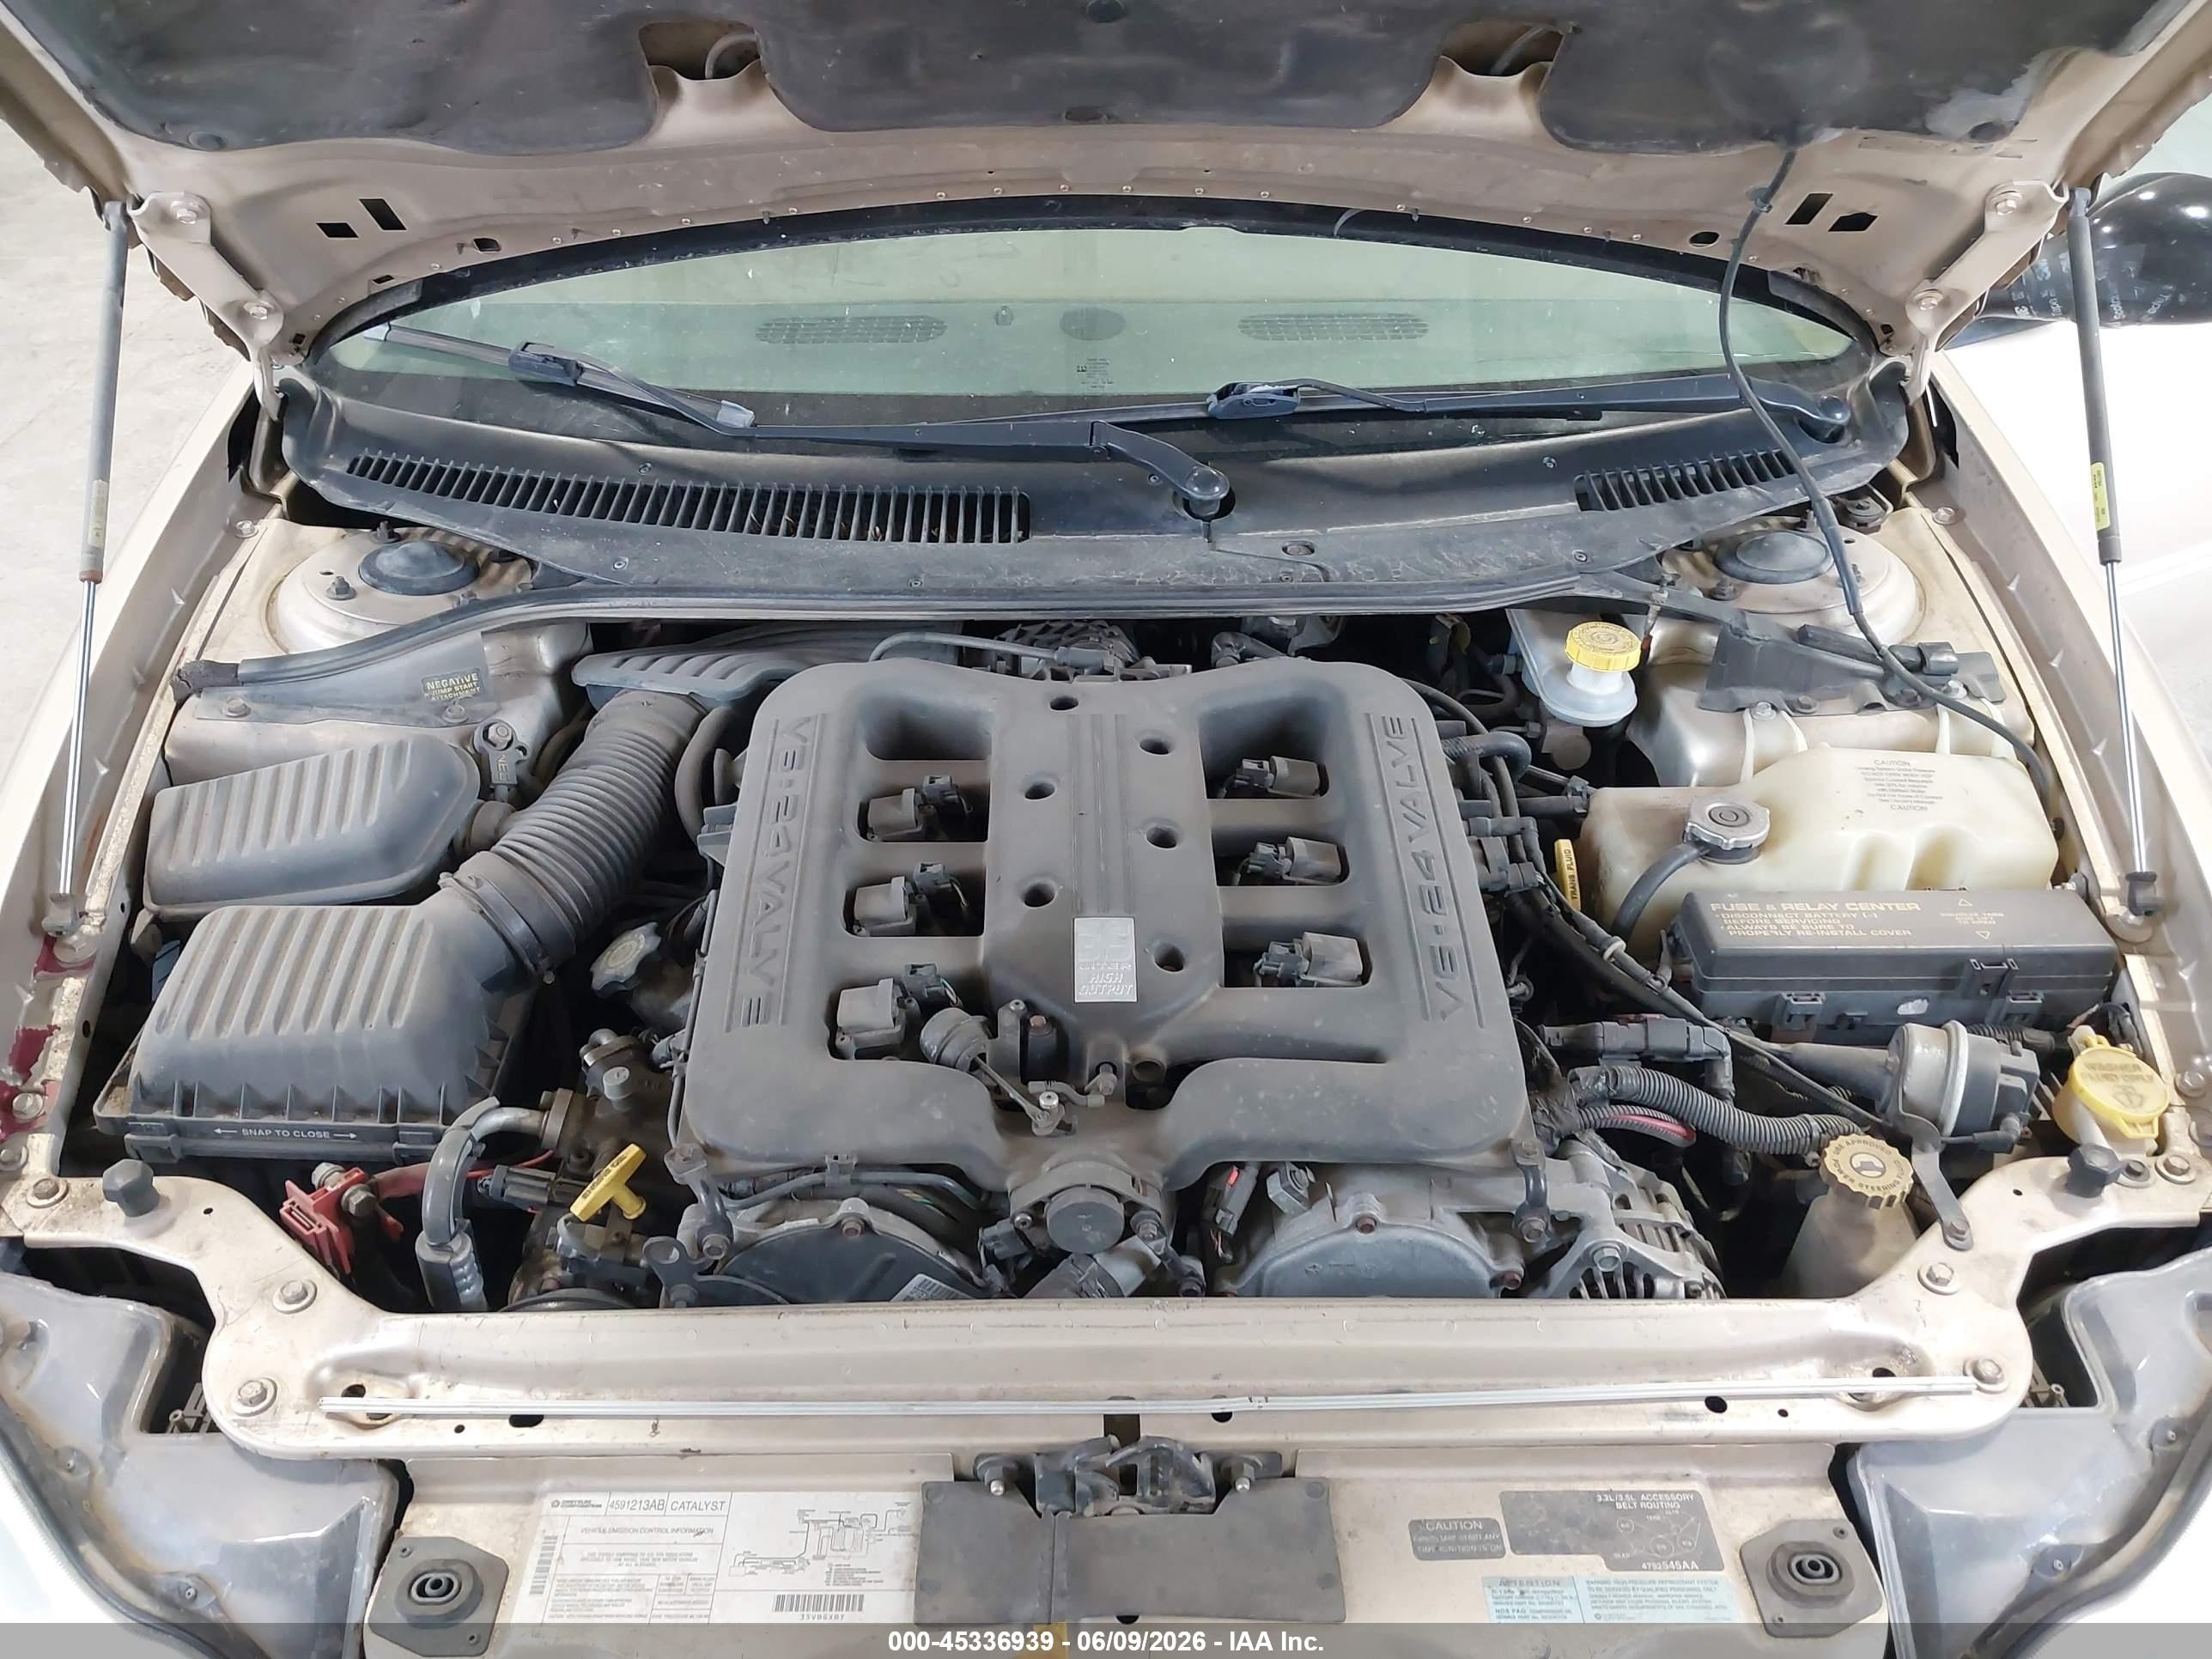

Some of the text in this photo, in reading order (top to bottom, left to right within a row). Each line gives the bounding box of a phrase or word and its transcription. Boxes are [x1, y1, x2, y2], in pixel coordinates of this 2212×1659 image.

[426, 673, 478, 690] NEGATIVE
[432, 681, 477, 696] JUMP START
[1382, 714, 1430, 844] VALVE
[1564, 848, 1578, 900] TRANS FLUID
[1711, 902, 1760, 911] FUSE
[1780, 902, 1839, 911] RELAY
[1845, 902, 1921, 911] CENTER
[740, 860, 789, 1028] VALVE
[1089, 972, 1123, 984] HIGH
[1079, 984, 1133, 995] OUTPUT
[241, 1128, 330, 1139] SNAP TO CLOSE
[1858, 1180, 1900, 1192] STEERING
[1641, 1492, 1694, 1502] ACCESSORY
[609, 1498, 665, 1511] 4591213AB
[671, 1500, 726, 1511] CATALYST
[1640, 1501, 1680, 1510] ROUTING
[1425, 1520, 1483, 1532] CAUTION
